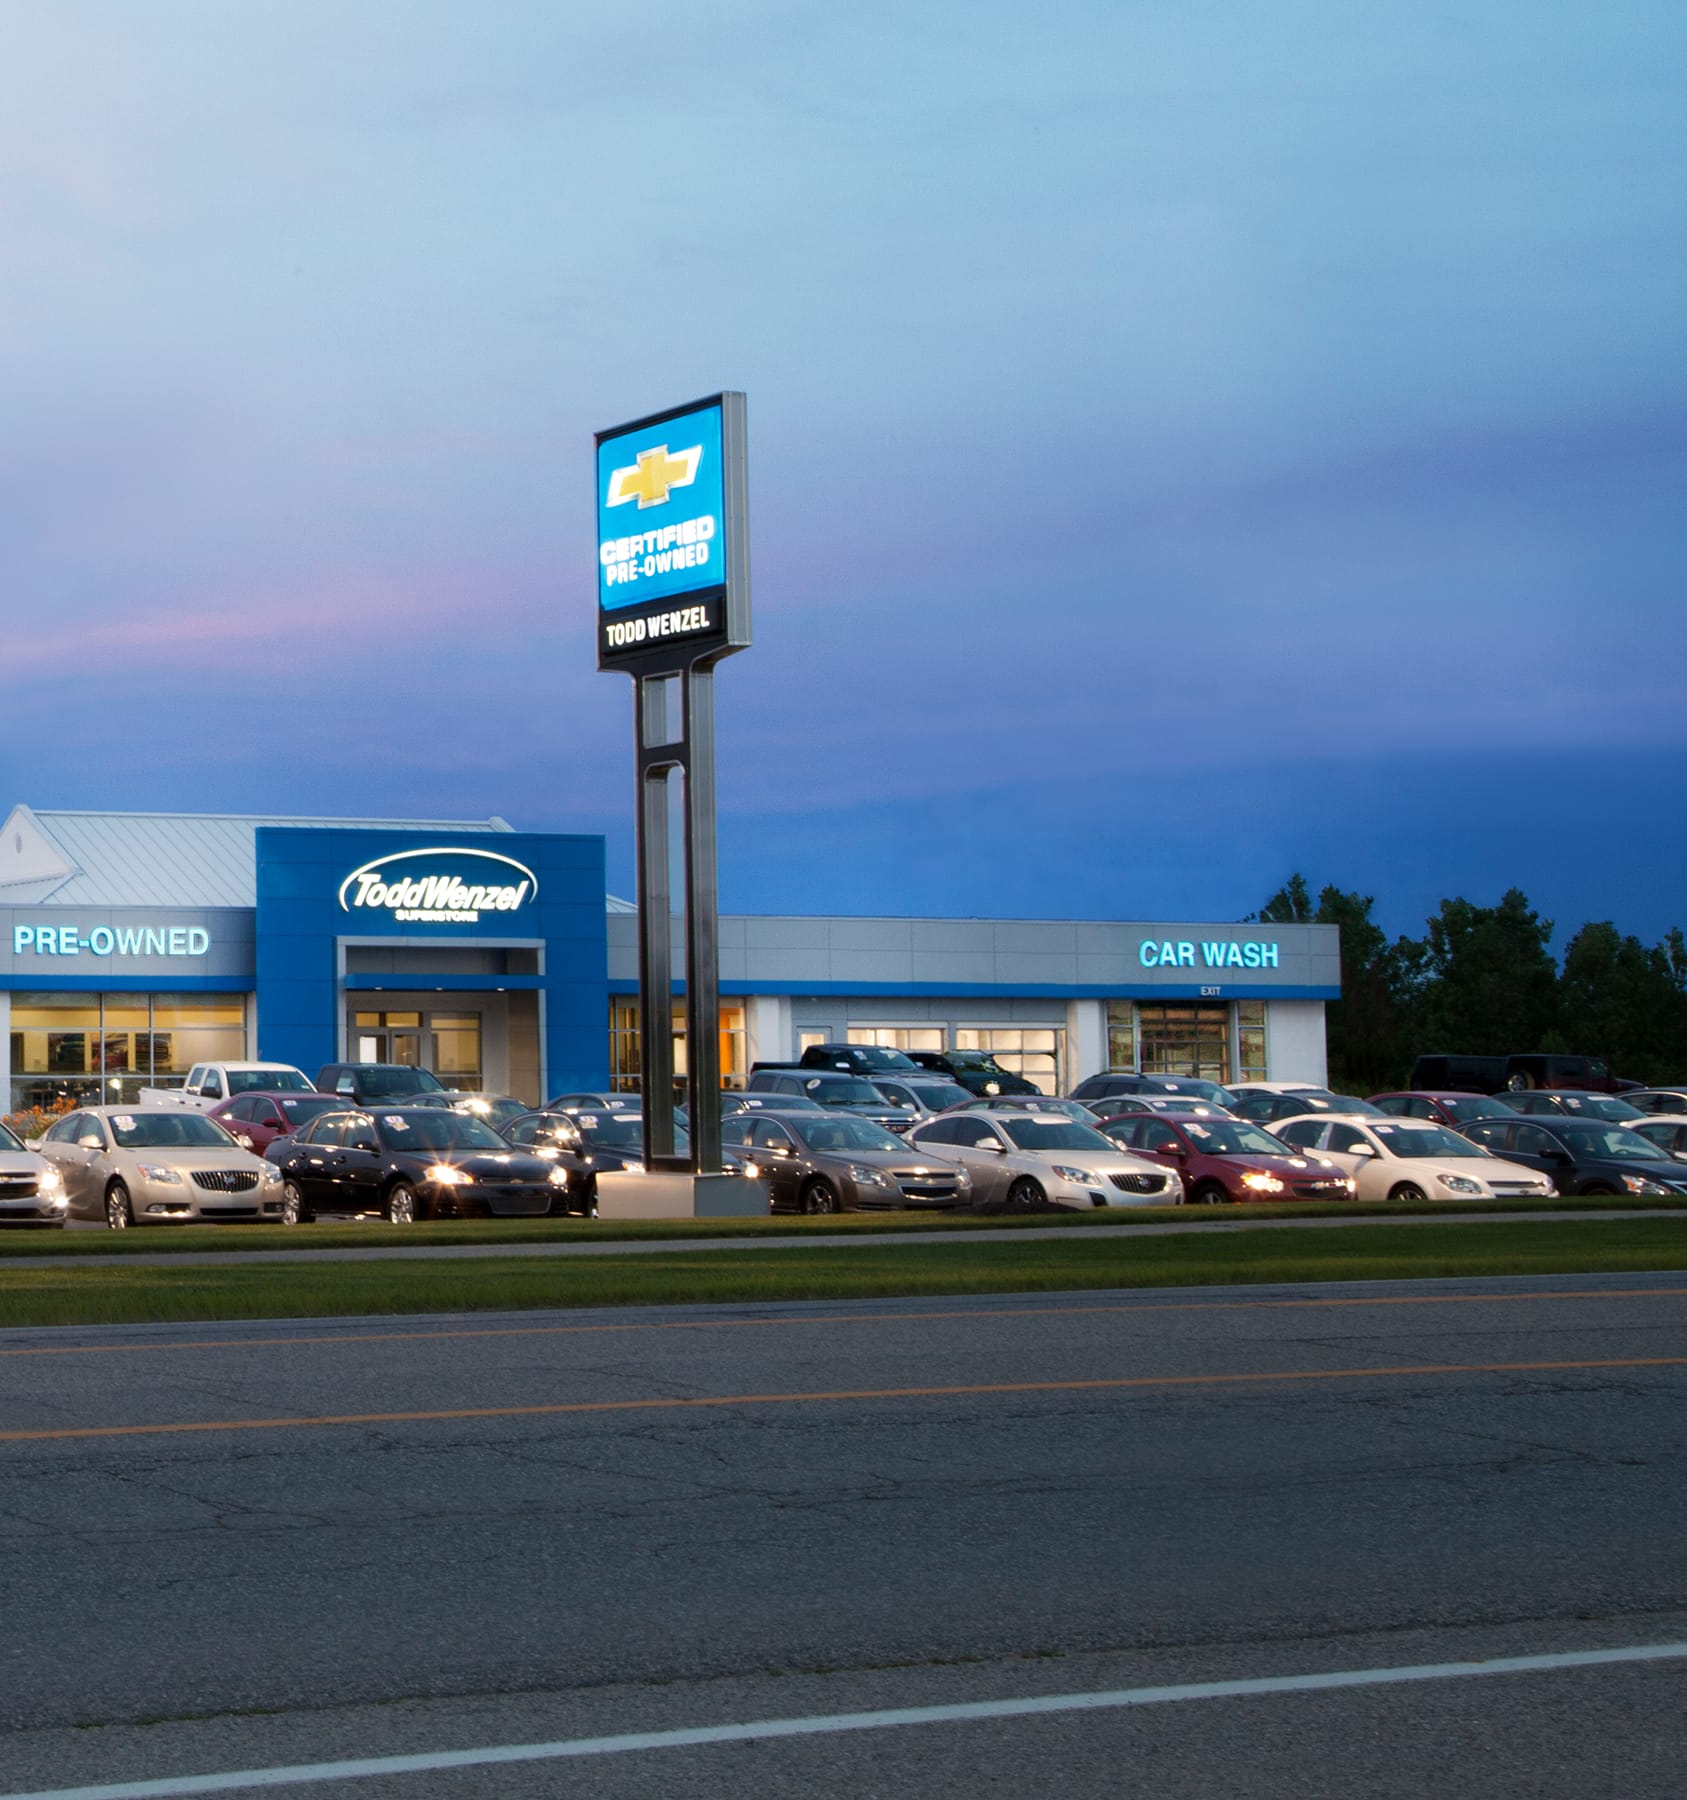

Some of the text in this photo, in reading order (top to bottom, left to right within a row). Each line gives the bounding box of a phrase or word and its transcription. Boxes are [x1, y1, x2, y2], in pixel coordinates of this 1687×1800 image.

[600, 515, 714, 565] CERTIFIED
[606, 542, 709, 586] PRE-OWNED
[606, 605, 710, 646] TODD WENZEL
[395, 910, 478, 922] SUPERSTORE
[14, 925, 209, 955] PRE-OWNED
[1139, 940, 1278, 967] CAR WASH
[1200, 986, 1221, 996] EXIT
